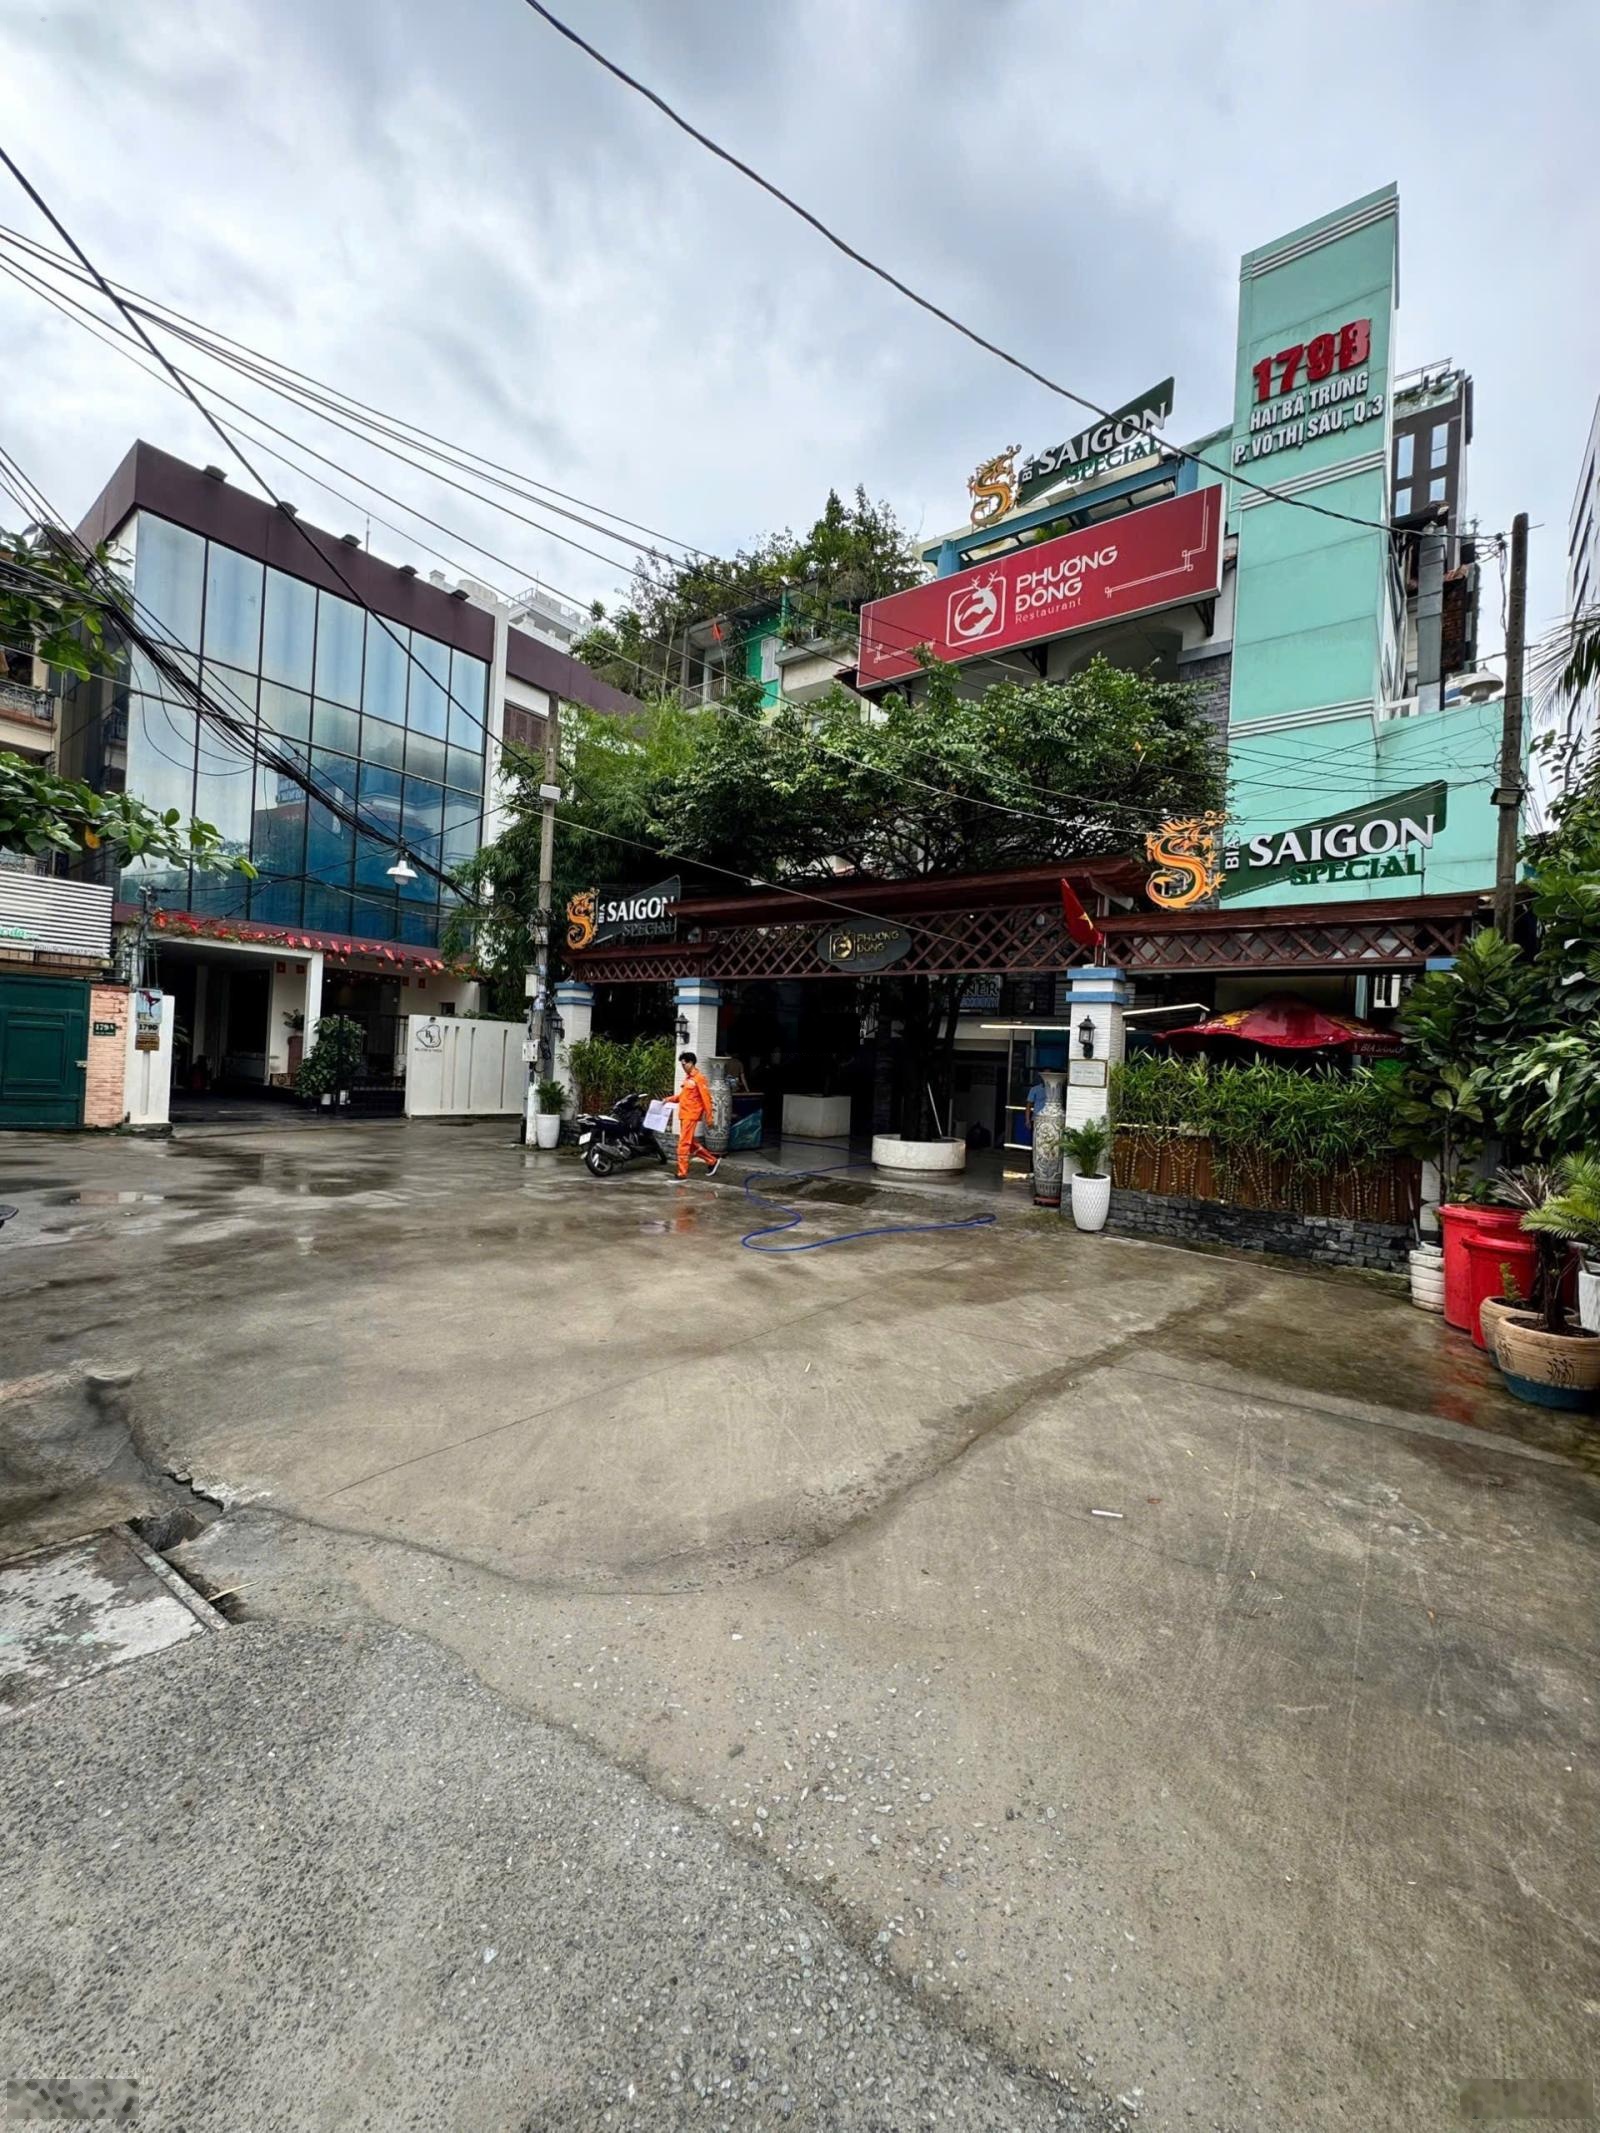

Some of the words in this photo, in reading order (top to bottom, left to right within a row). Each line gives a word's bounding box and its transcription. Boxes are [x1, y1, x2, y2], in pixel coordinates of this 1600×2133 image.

[1252, 319, 1372, 403] 179B
[1251, 406, 1277, 431] HAI
[1282, 392, 1305, 420] BÀ
[1310, 371, 1368, 409] TRƯNG
[1039, 401, 1167, 476] SAIGON
[1234, 444, 1247, 464] P.
[1252, 434, 1272, 457] VÕ
[1277, 421, 1303, 446] THỊ
[1353, 394, 1384, 422] Q.3
[1065, 439, 1162, 484] SPECIAL
[1016, 545, 1118, 593] PHƯƠNG
[1015, 577, 1082, 613] ĐÔNG
[1015, 597, 1081, 624] Restaurant
[1224, 830, 1240, 870] BIA
[1248, 814, 1436, 868] SAIGON
[1289, 853, 1425, 885] SPECIAL
